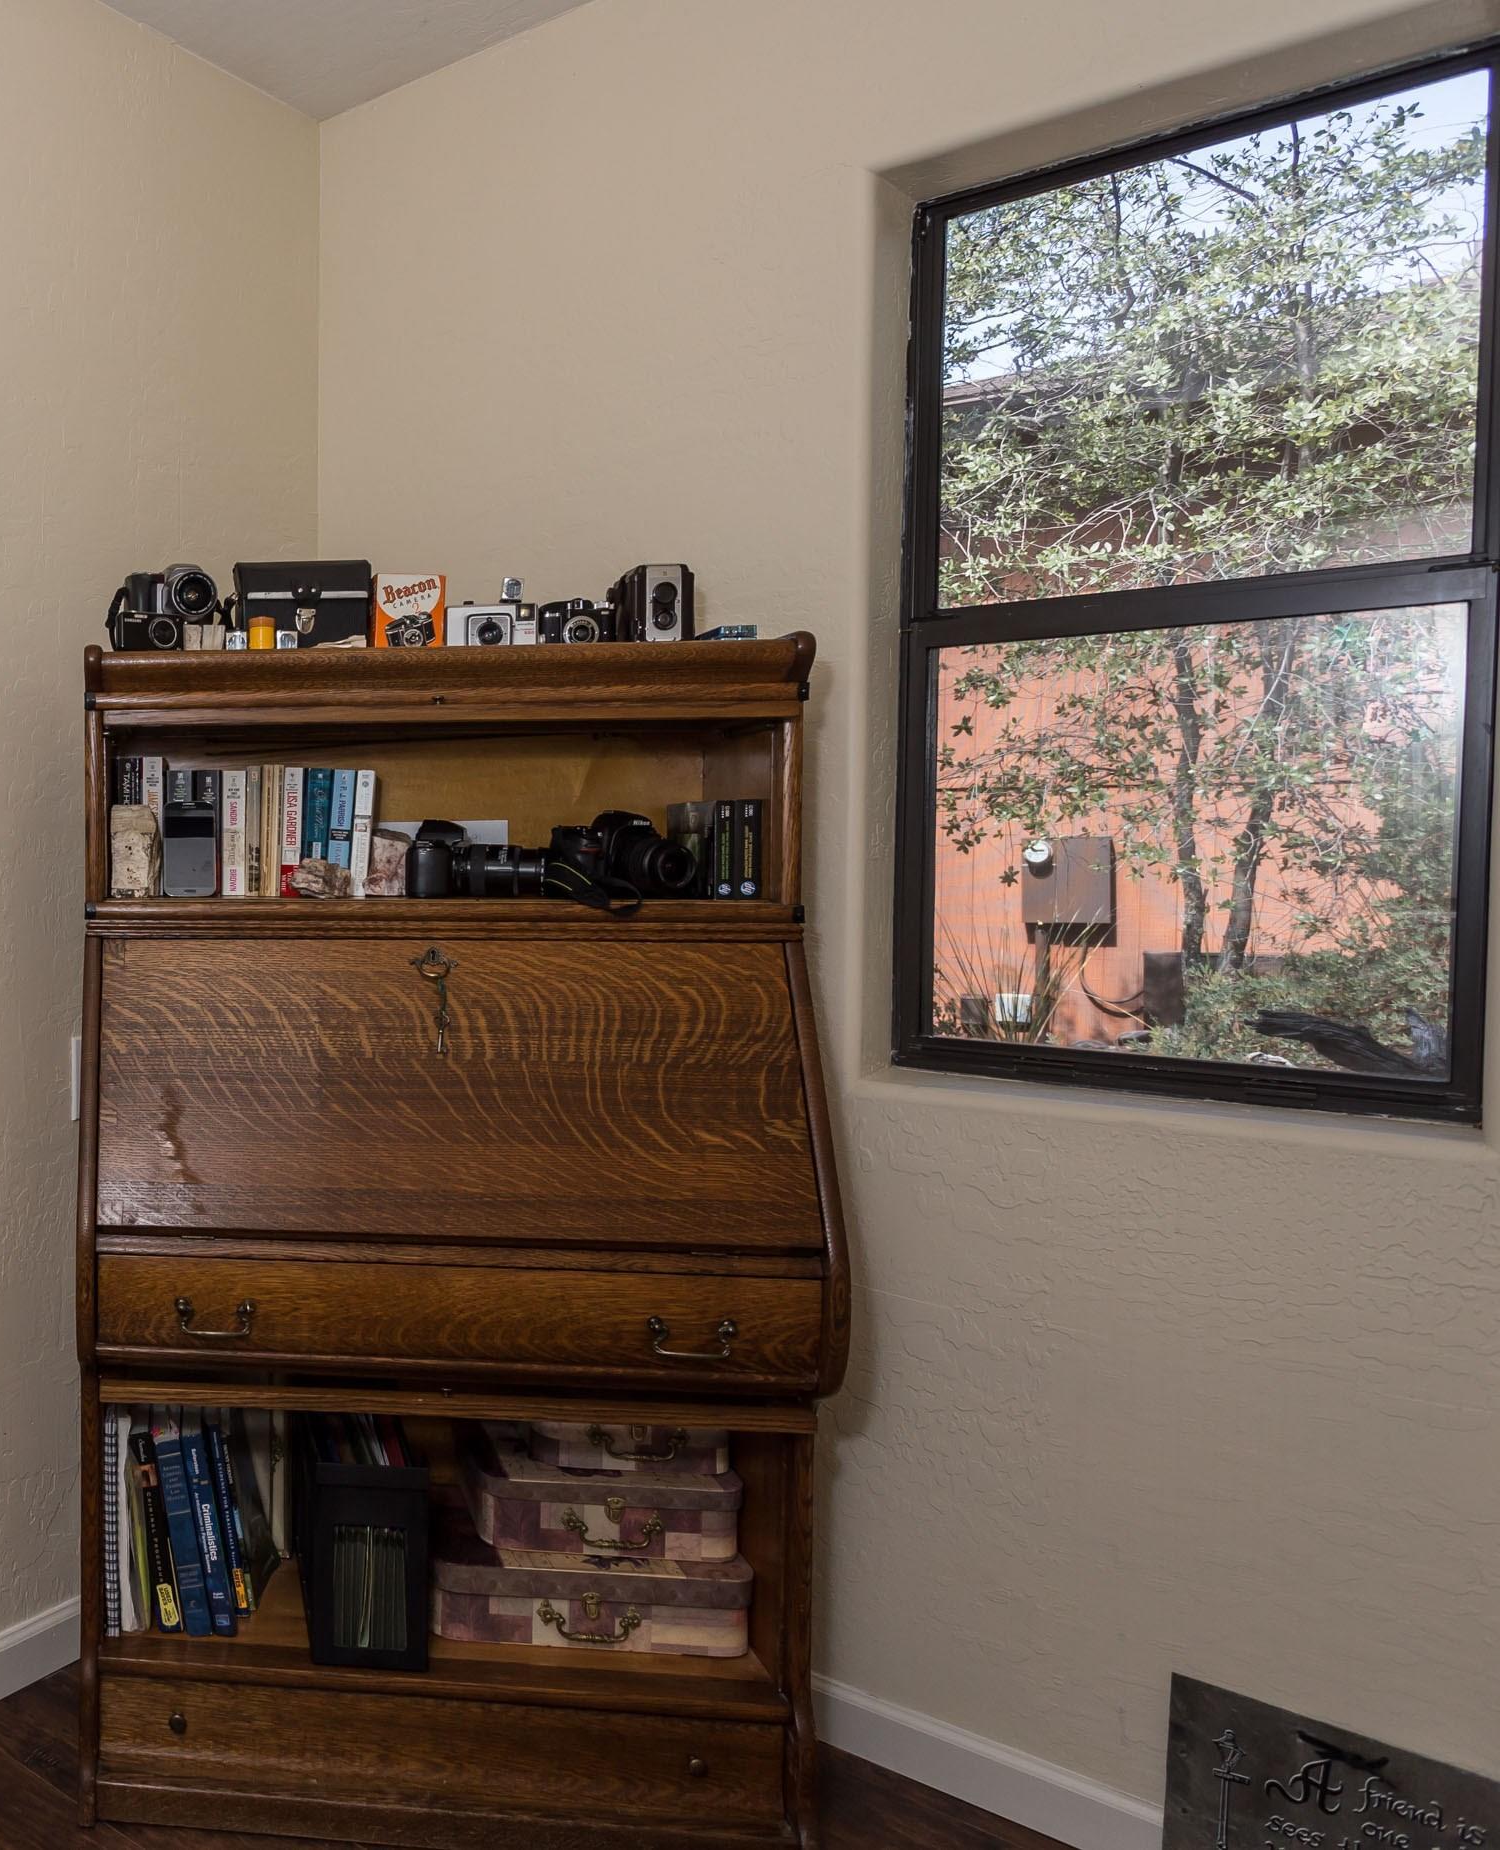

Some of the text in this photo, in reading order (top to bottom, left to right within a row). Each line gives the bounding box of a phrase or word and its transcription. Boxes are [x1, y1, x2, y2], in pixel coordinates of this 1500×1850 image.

[382, 578, 438, 605] Beacon
[393, 593, 431, 609] CAMERA
[123, 773, 131, 795] TAMI
[229, 801, 238, 826] SANDRA
[286, 791, 298, 809] LISA
[337, 800, 347, 827] PARRISH
[285, 811, 298, 847] GARDNER
[229, 868, 237, 892] BROWN
[201, 1503, 218, 1562] Criminalistics
[153, 1537, 164, 1583] PROCEDUR
[1264, 1758, 1487, 1845] A friend is
[1264, 1815, 1326, 1847] sees
[1361, 1821, 1411, 1849] one
